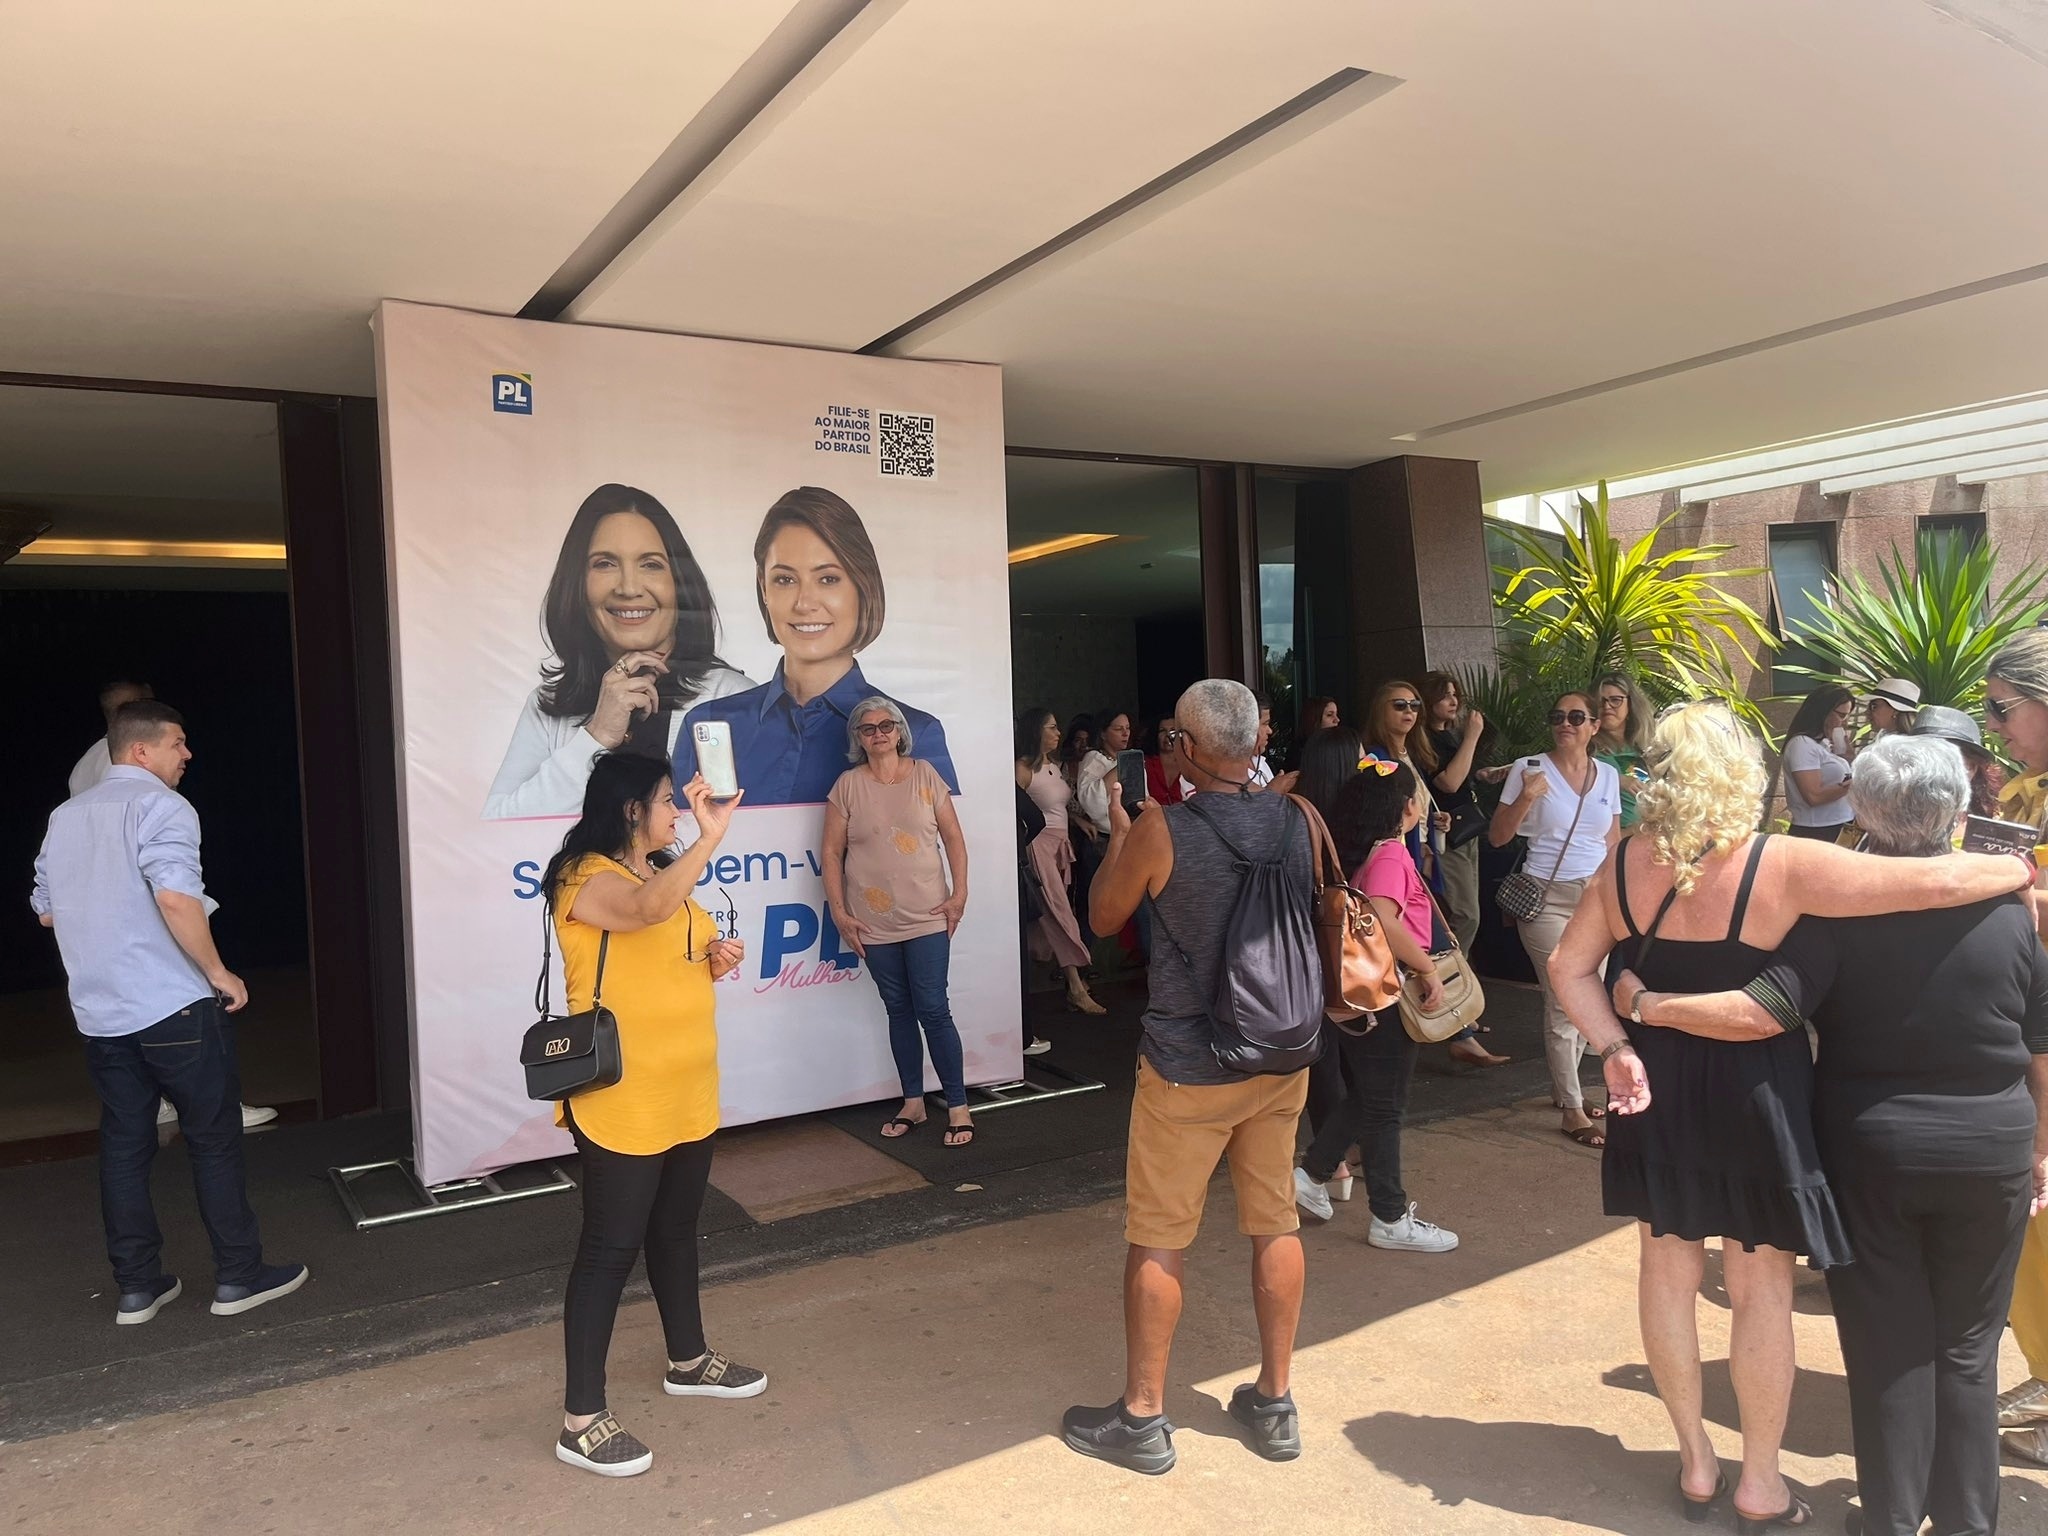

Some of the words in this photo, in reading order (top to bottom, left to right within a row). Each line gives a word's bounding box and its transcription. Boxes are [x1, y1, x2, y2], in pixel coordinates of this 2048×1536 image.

[498, 380, 528, 403] PL
[828, 405, 870, 419] FILIE-SE
[815, 417, 832, 427] AO
[833, 418, 870, 431] MAIOR
[823, 430, 871, 442] PARTIDO
[815, 441, 832, 451] DO
[834, 442, 871, 455] BRASIL
[760, 901, 859, 979] PL
[754, 960, 862, 993] Mulher
